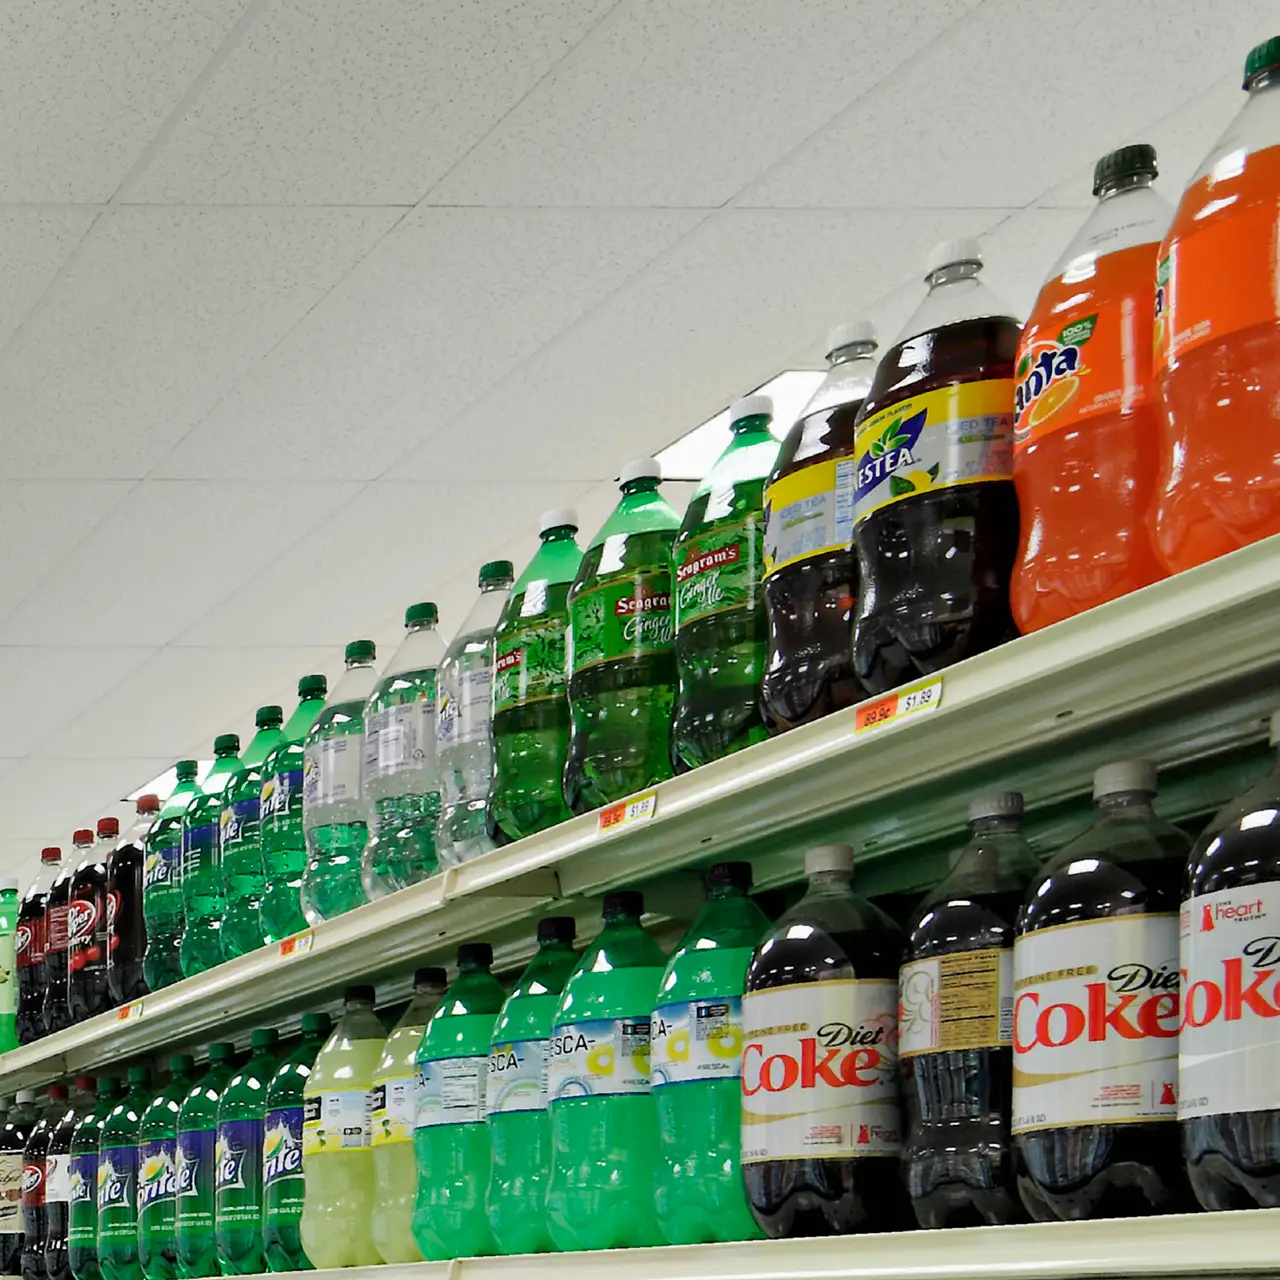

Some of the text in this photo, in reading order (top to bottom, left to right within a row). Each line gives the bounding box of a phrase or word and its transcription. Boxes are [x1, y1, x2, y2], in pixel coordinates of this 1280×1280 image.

[676, 546, 738, 582] Seagram's
[1215, 898, 1264, 922] heart
[1056, 965, 1097, 980] FREE
[817, 1022, 885, 1048] Diet
[1013, 983, 1181, 1056] Coke
[742, 1038, 883, 1098] Coke
